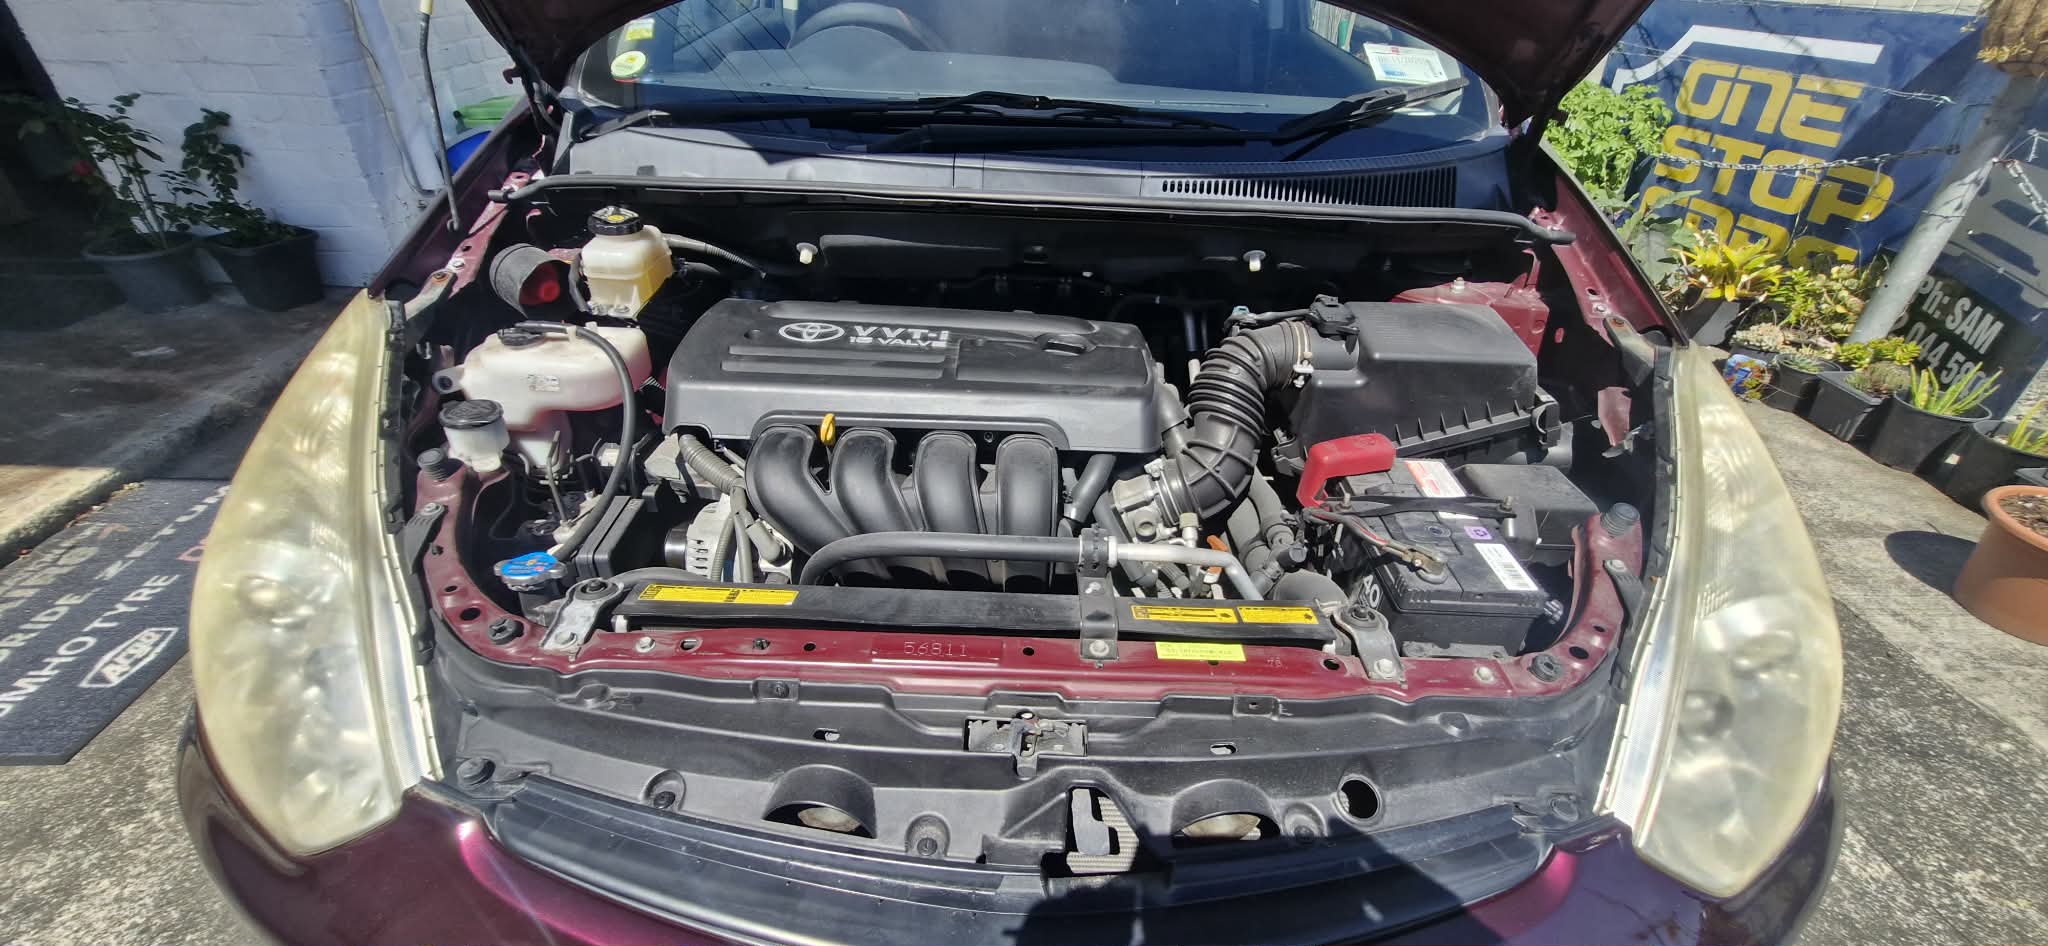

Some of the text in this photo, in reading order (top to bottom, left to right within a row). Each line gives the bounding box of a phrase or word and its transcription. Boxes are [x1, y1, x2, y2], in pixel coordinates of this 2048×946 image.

[1676, 58, 1866, 148] ONE
[1654, 125, 1894, 225] STOP
[849, 336, 948, 348] 16 VALVE
[1945, 297, 2004, 355] SAM
[82, 574, 180, 632] TYRE
